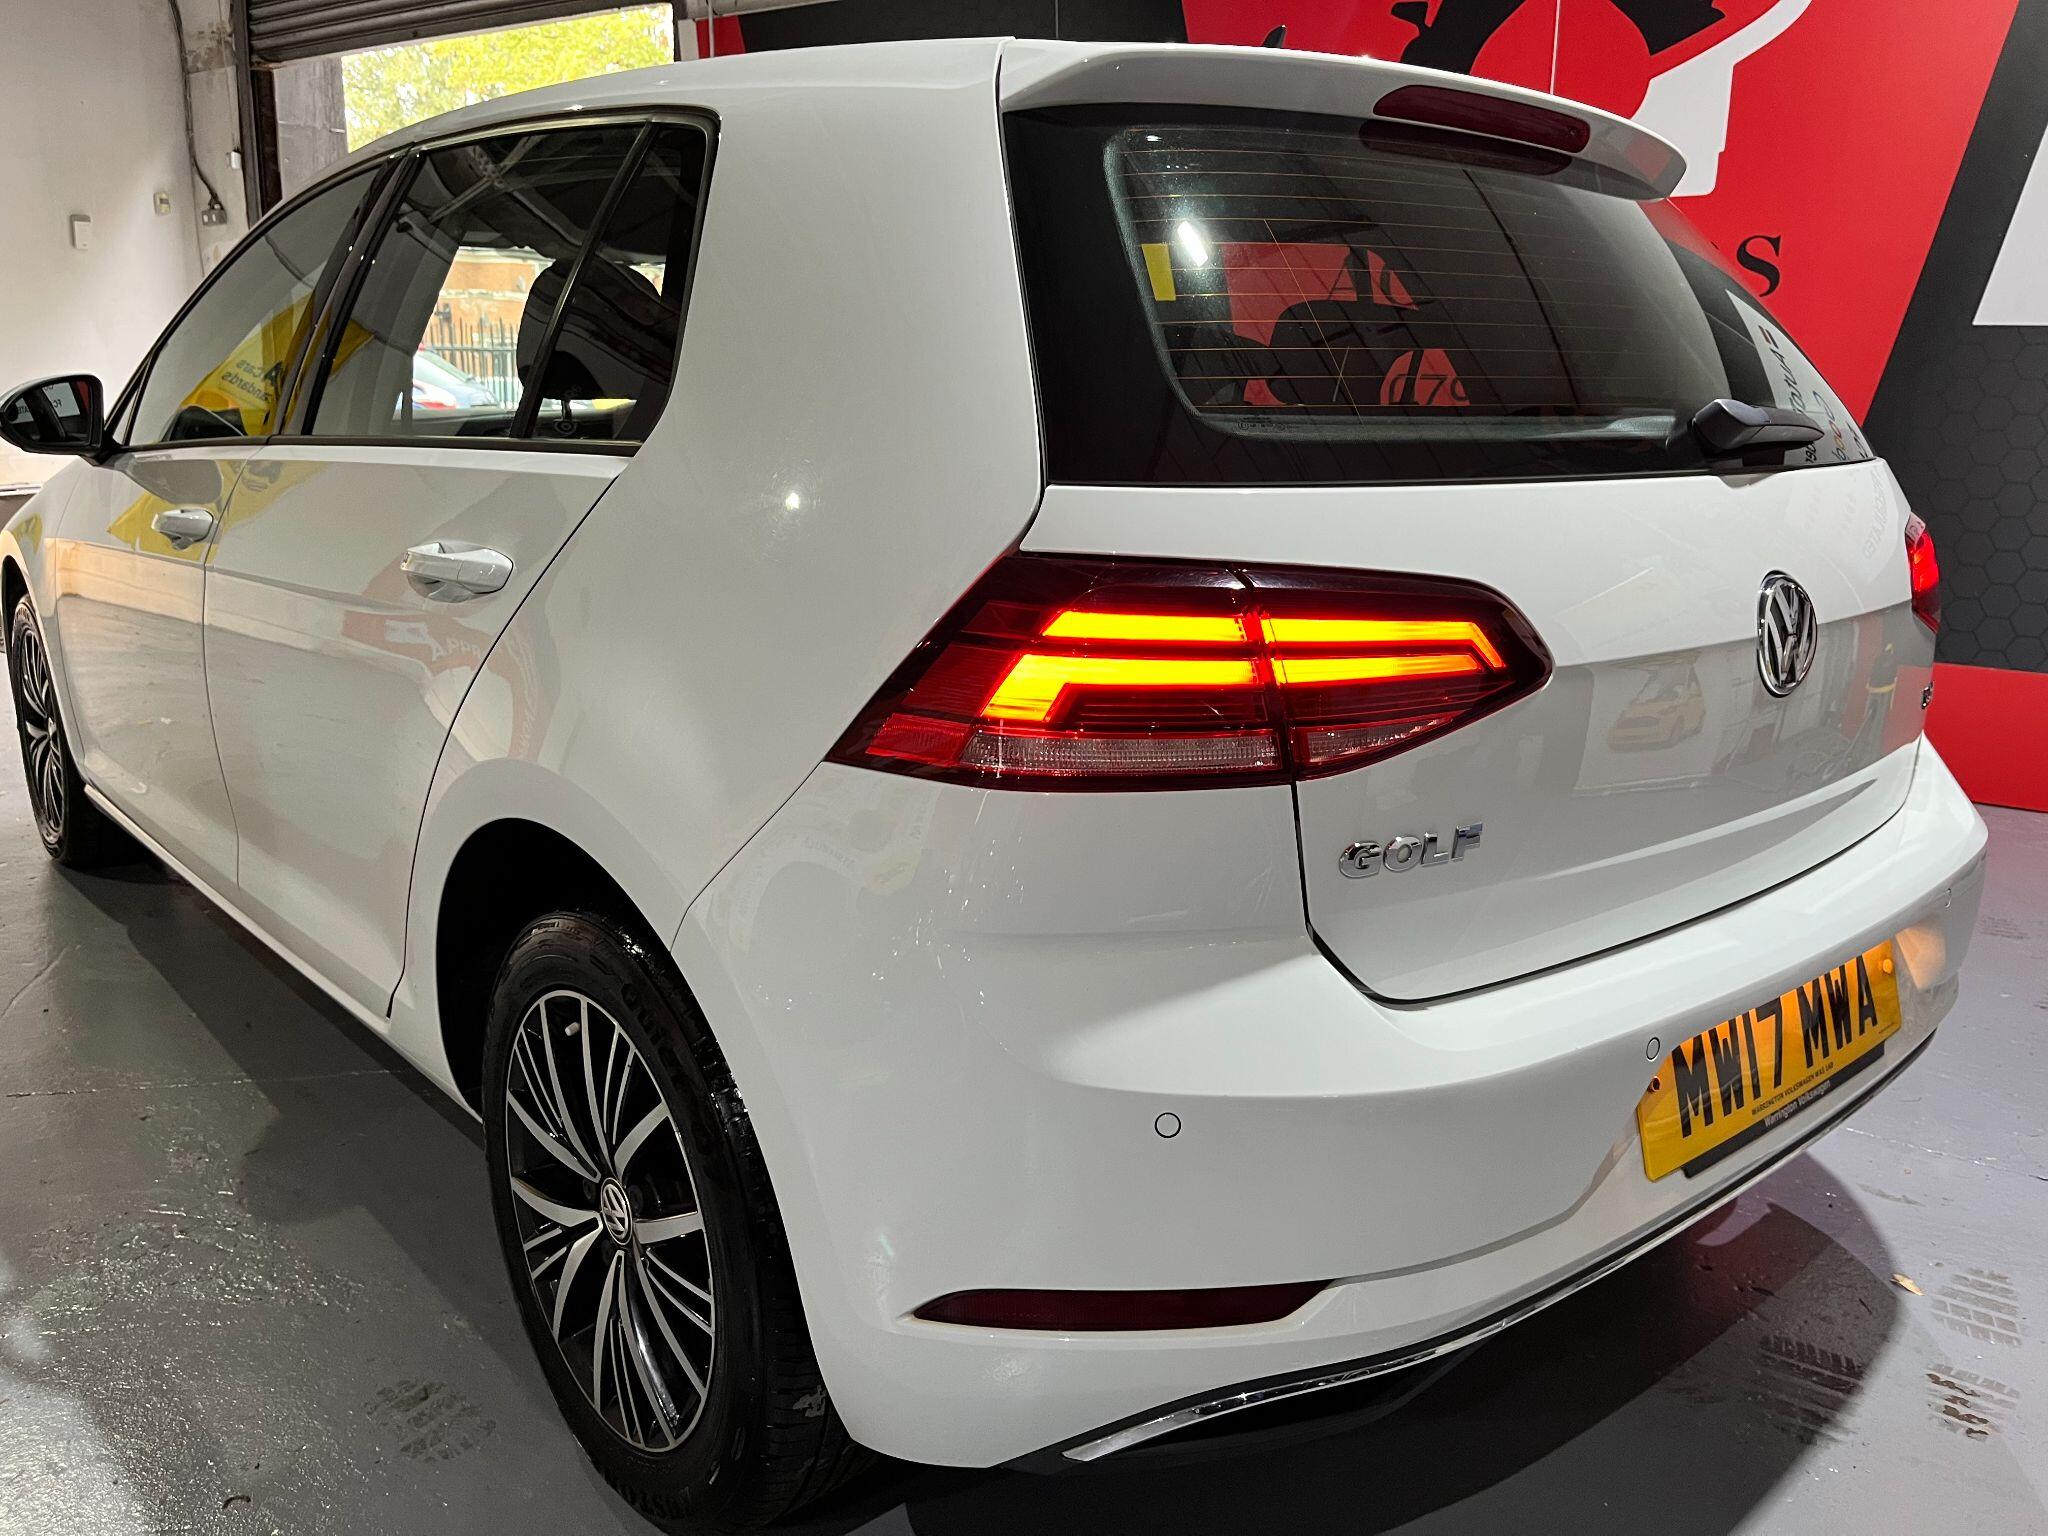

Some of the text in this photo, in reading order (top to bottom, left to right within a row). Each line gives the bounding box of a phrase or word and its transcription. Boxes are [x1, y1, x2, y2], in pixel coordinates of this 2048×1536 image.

[1338, 821, 1485, 879] GOLF
[1671, 954, 1879, 1139] MW17 MWA
[1764, 1080, 1831, 1127] Warrington Volkswagen
